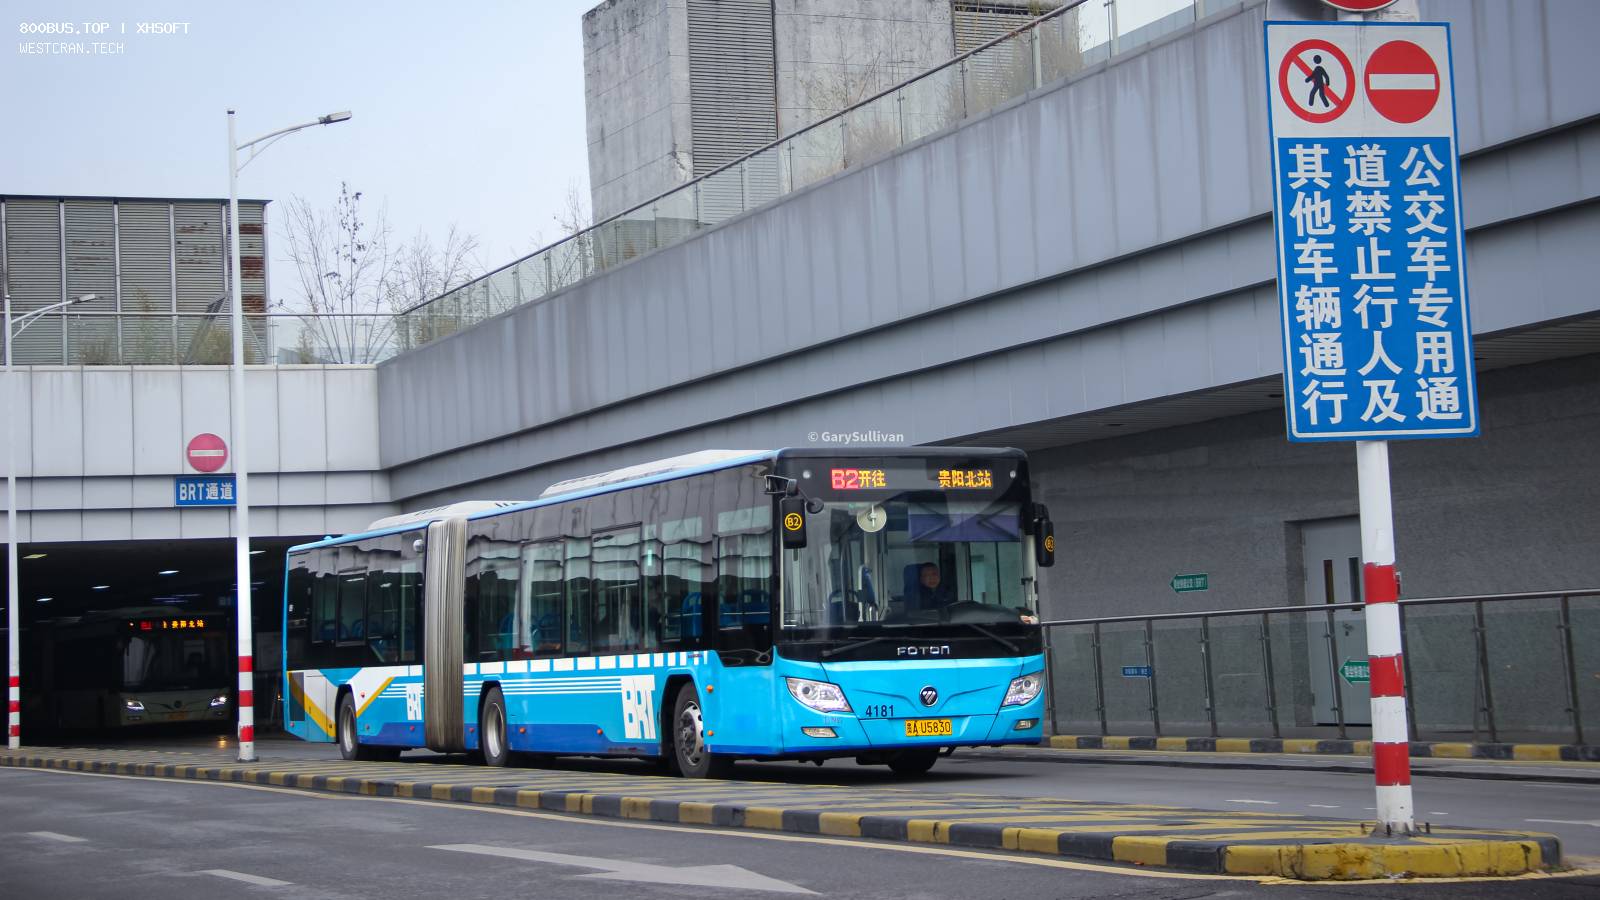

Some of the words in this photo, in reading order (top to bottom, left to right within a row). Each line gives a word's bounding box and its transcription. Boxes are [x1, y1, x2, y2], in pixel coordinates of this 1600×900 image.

[1287, 144, 1347, 425] 其他车辆通行
[1344, 144, 1406, 424] 道禁止行人及
[1400, 144, 1463, 421] 公交车专用通
[938, 469, 993, 488] 贵阳北站
[179, 482, 234, 500] BRT通道
[786, 516, 800, 527] B2
[896, 645, 950, 656] FOTON
[620, 674, 657, 739] BRT
[865, 704, 895, 718] 4181
